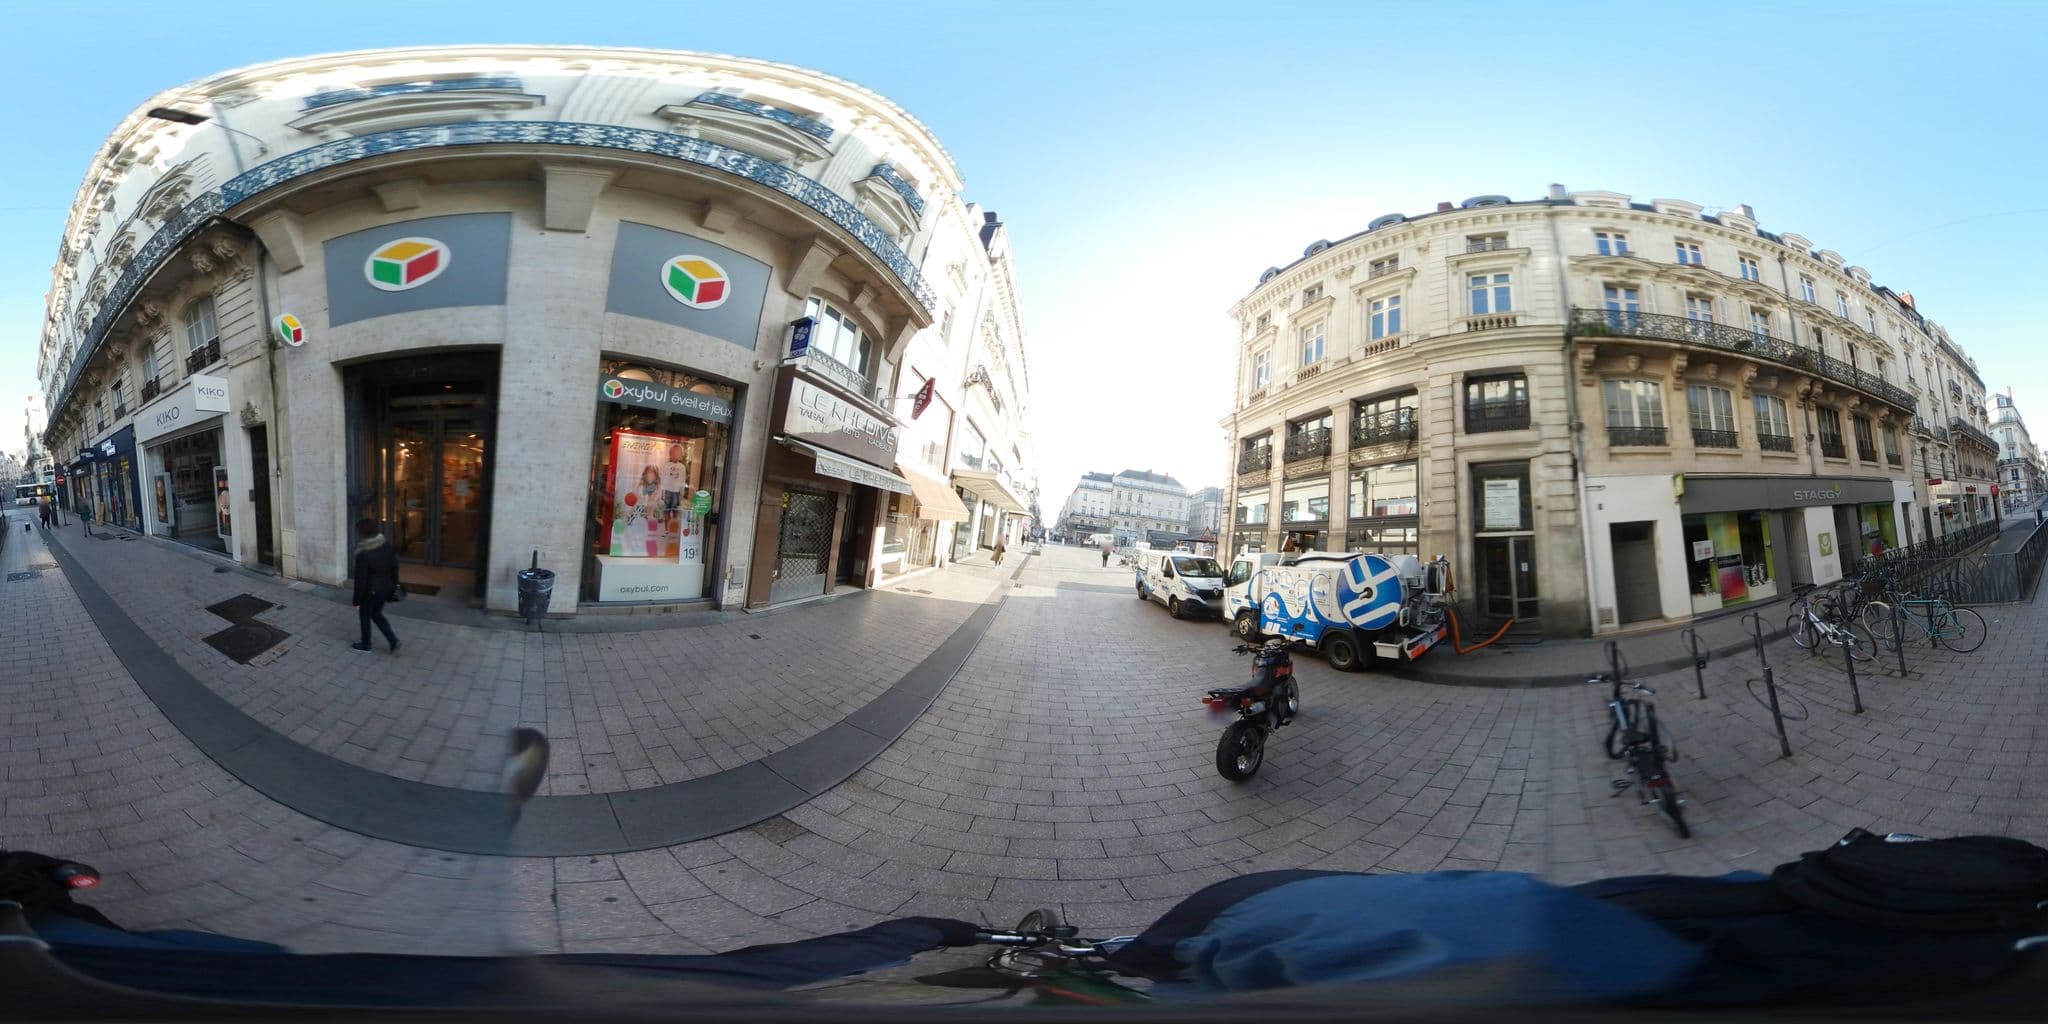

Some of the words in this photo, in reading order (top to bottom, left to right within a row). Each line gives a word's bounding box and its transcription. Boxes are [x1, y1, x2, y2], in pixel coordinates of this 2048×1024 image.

[198, 386, 225, 397] KIKO
[671, 392, 698, 408] éveil
[698, 400, 710, 411] et
[710, 401, 733, 417] jeux
[800, 386, 826, 413] LE
[156, 406, 180, 426] KIKO
[841, 425, 860, 438] LOTO
[1793, 489, 1842, 501] STAGGY
[683, 547, 695, 560] 19
[620, 585, 669, 594] oxybul.com
